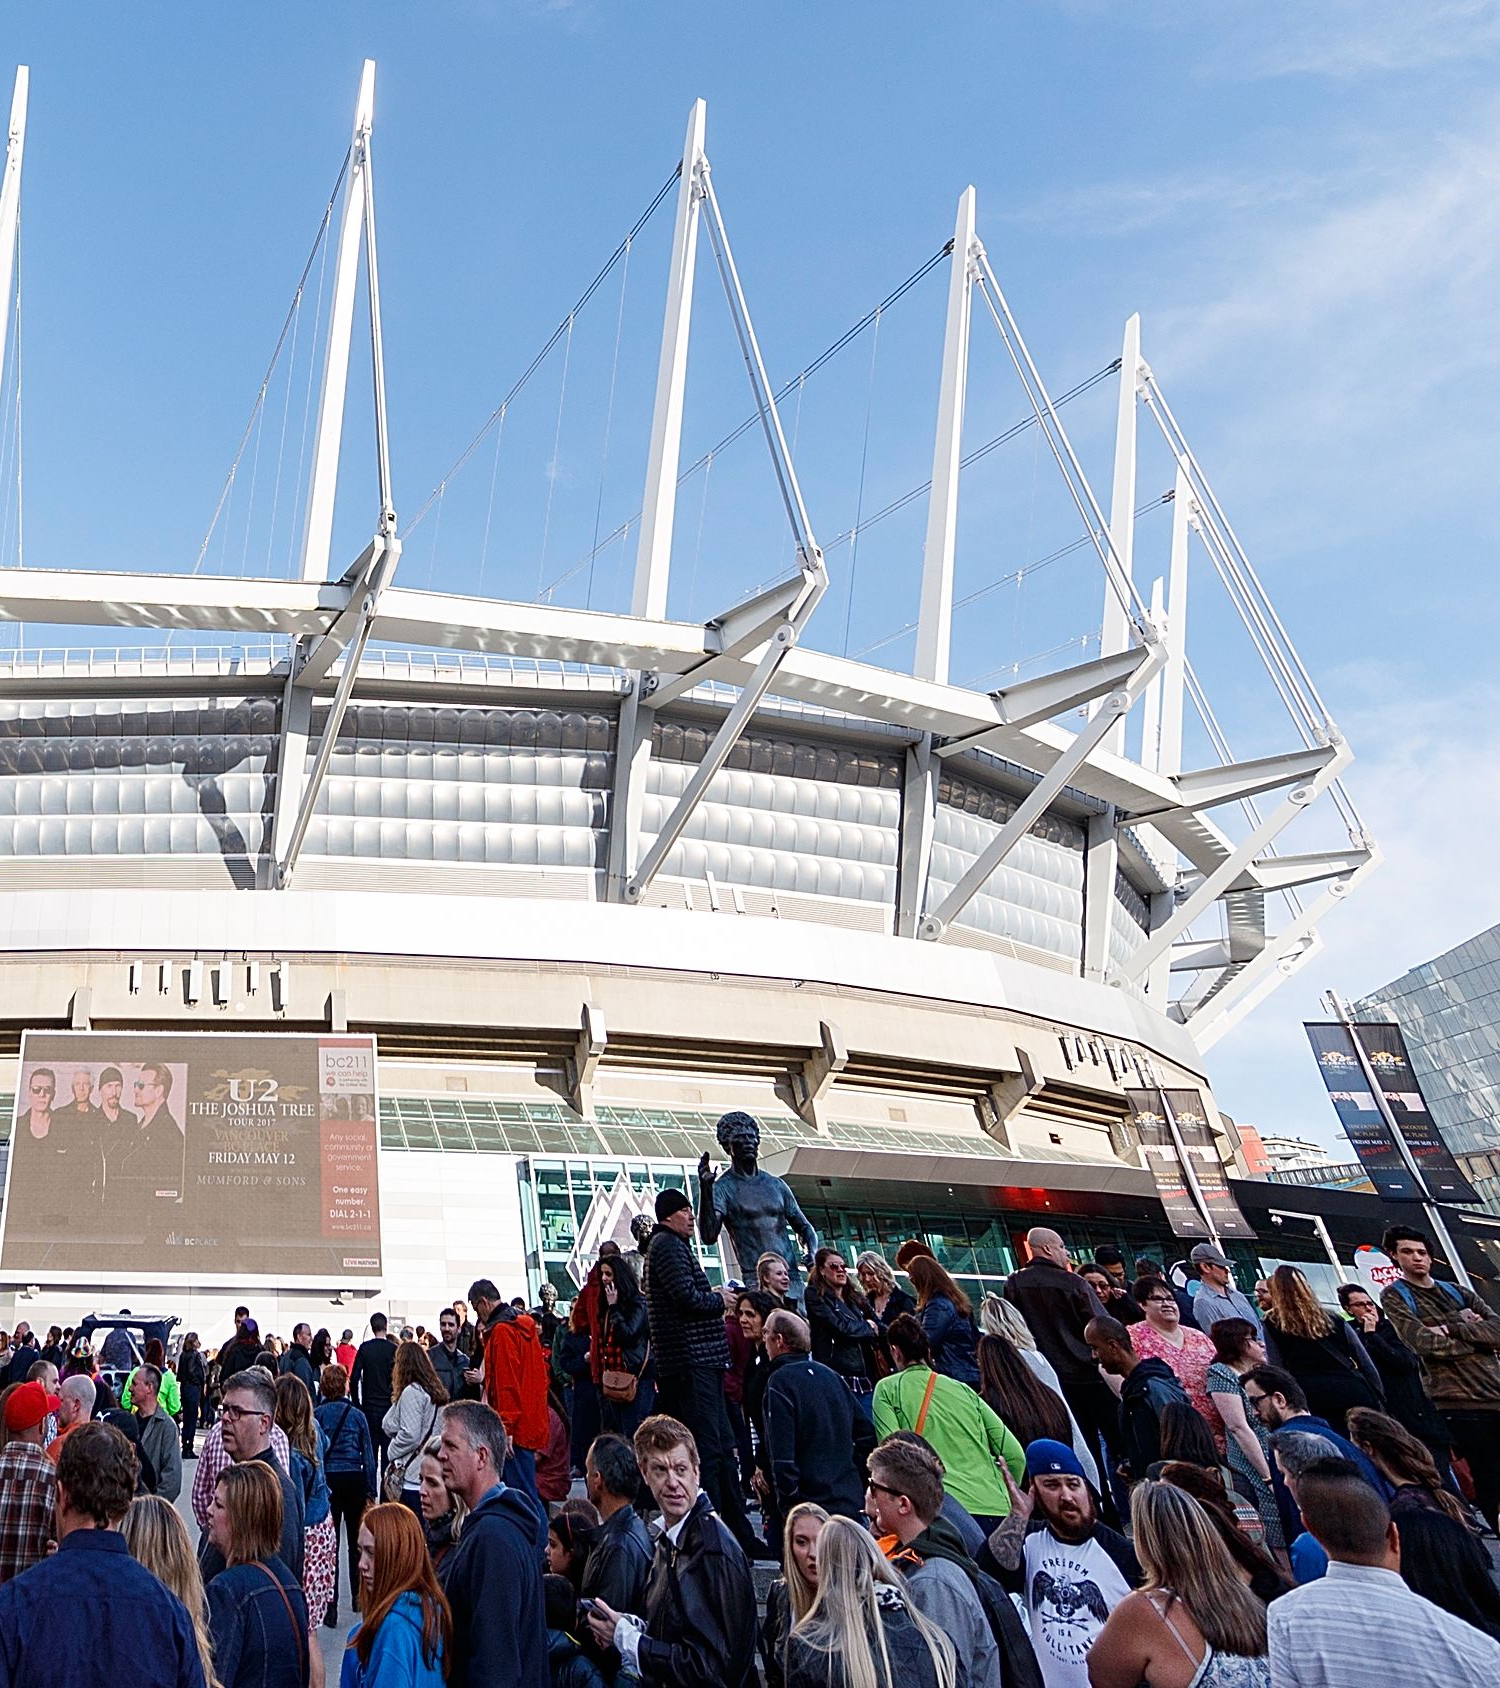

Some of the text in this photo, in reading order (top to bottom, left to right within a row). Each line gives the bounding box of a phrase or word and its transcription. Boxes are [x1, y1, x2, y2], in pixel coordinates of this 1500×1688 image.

[325, 1053, 367, 1068] bc211
[227, 1078, 279, 1102] U2
[189, 1102, 315, 1118] THE JOSHUA TREE
[228, 1118, 276, 1127] TOUR 2017
[214, 1129, 289, 1142] VANCOUVER
[330, 1133, 343, 1141] Any
[223, 1141, 280, 1152] BC PLACE
[324, 1144, 364, 1152] community
[209, 1152, 296, 1164] FRIDAY MAY 12
[327, 1153, 372, 1162] government
[196, 1175, 307, 1186] MUMFORD & SONS
[350, 1187, 367, 1195] easy
[335, 1197, 366, 1206] number.
[329, 1209, 371, 1218] DIAL 2-1-1
[358, 1259, 378, 1267] NATION
[1041, 1557, 1090, 1577] FREEDOM
[1041, 1627, 1062, 1653] FULL
